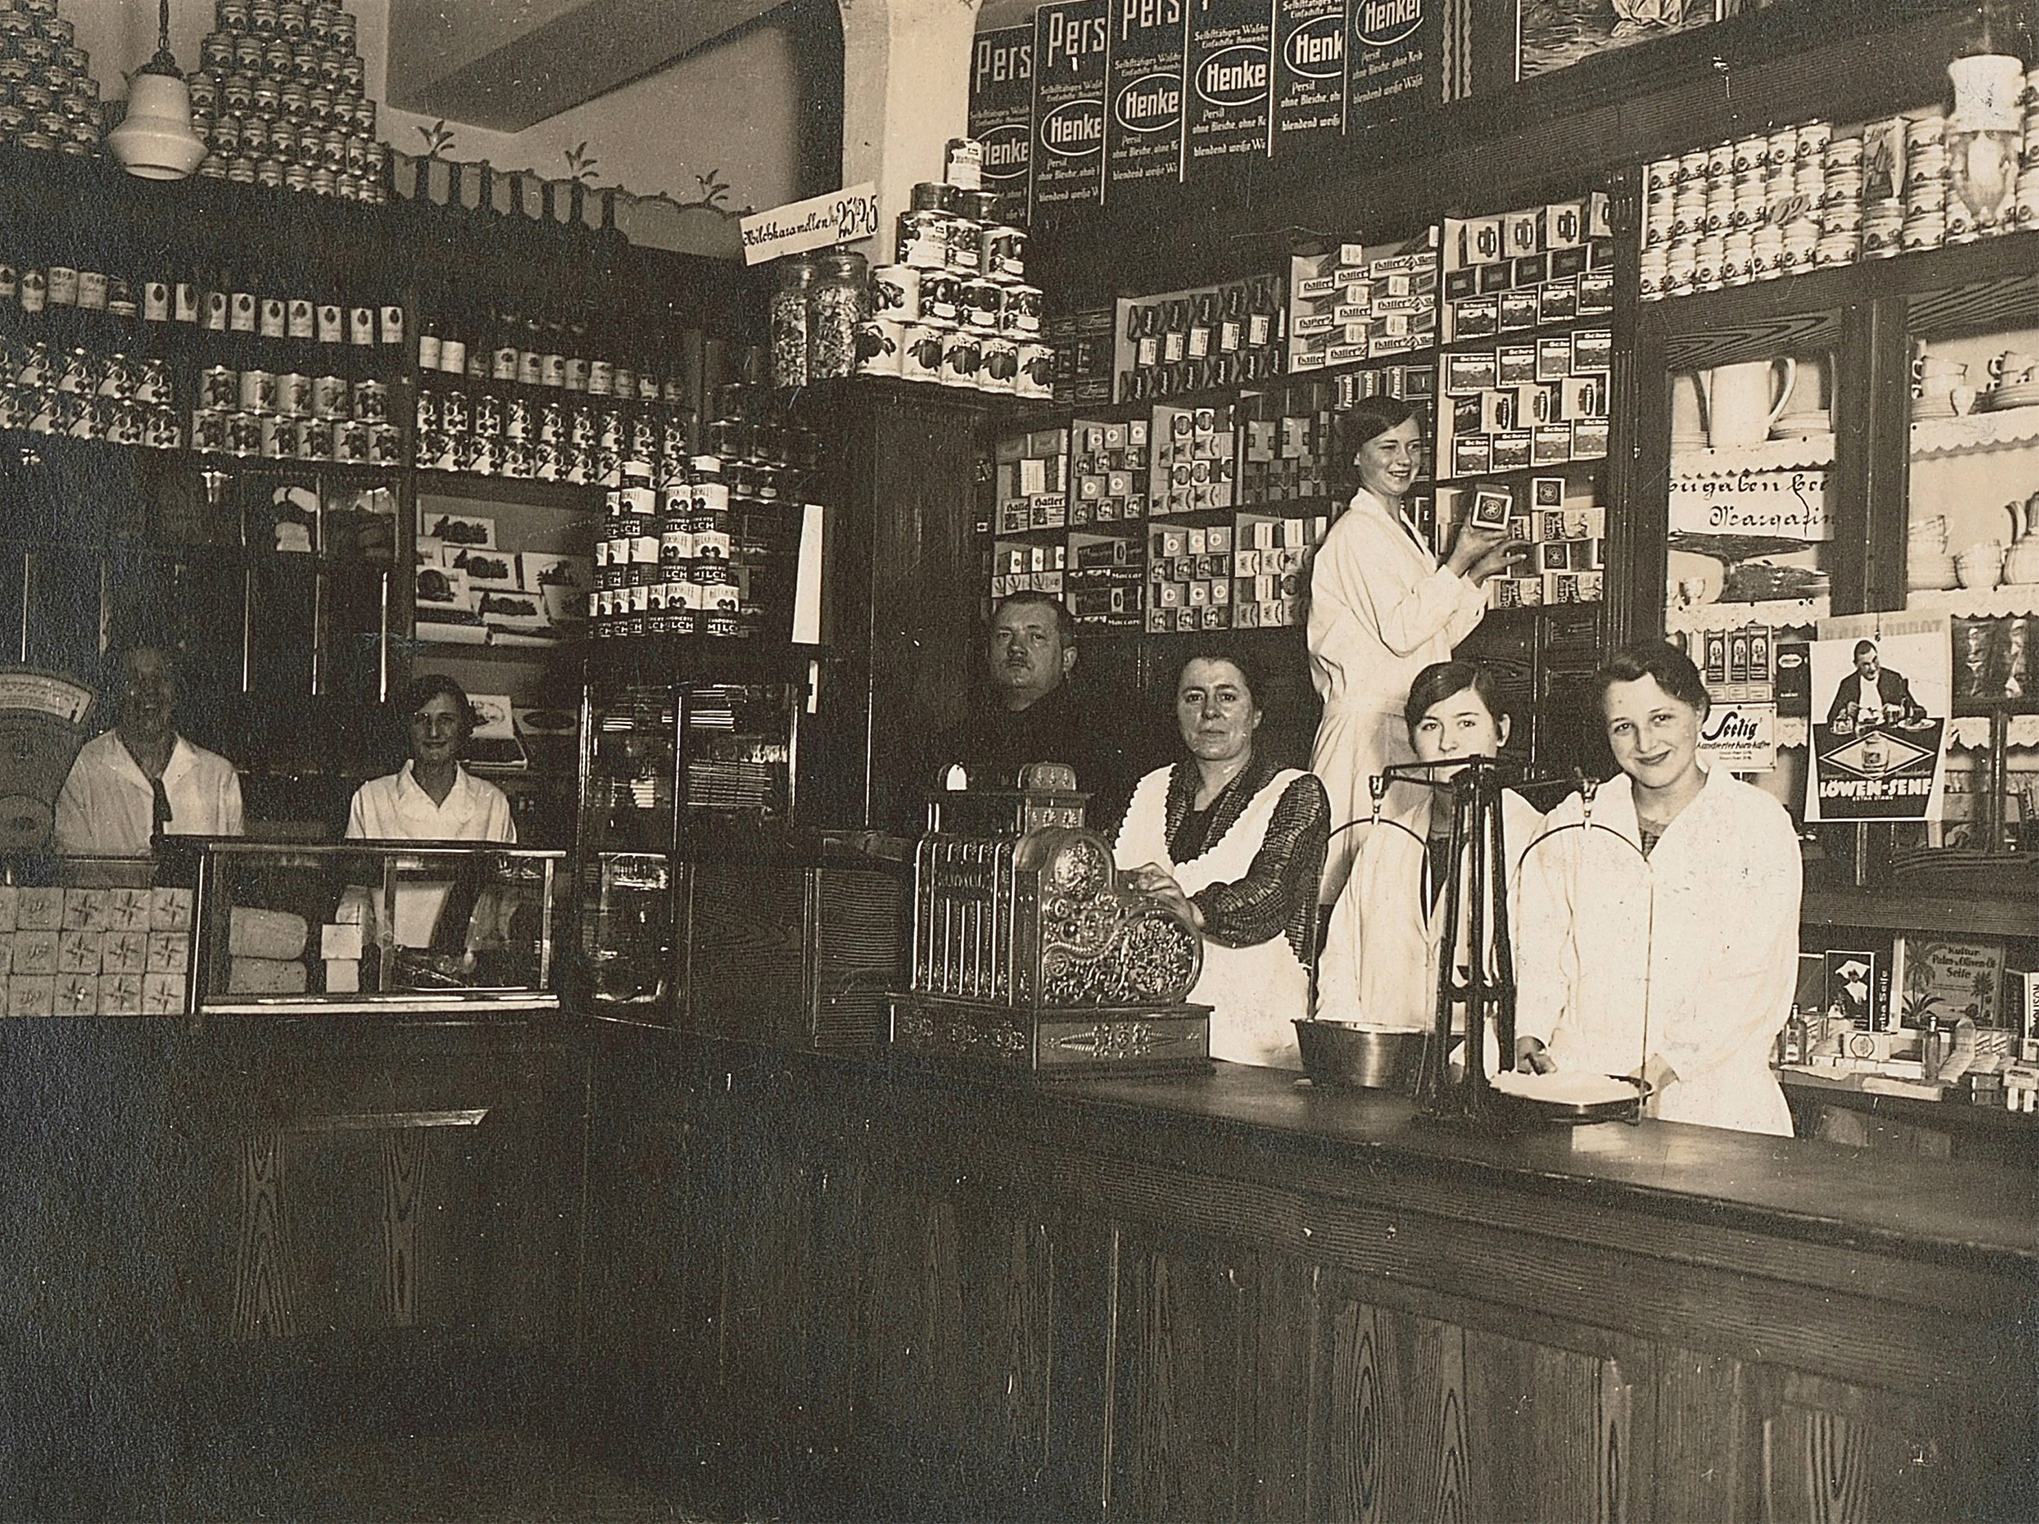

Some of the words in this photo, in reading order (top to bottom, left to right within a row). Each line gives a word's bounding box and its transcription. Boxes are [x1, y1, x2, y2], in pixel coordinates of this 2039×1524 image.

[1206, 60, 1266, 92] Henke
[1292, 80, 1316, 95] Persil
[1125, 87, 1179, 119] Henke
[1282, 117, 1317, 131] blendend
[1193, 145, 1227, 157] blendend
[1820, 778, 1932, 798] LÖWEN-SENF
[1879, 970, 1890, 1002] Seife
